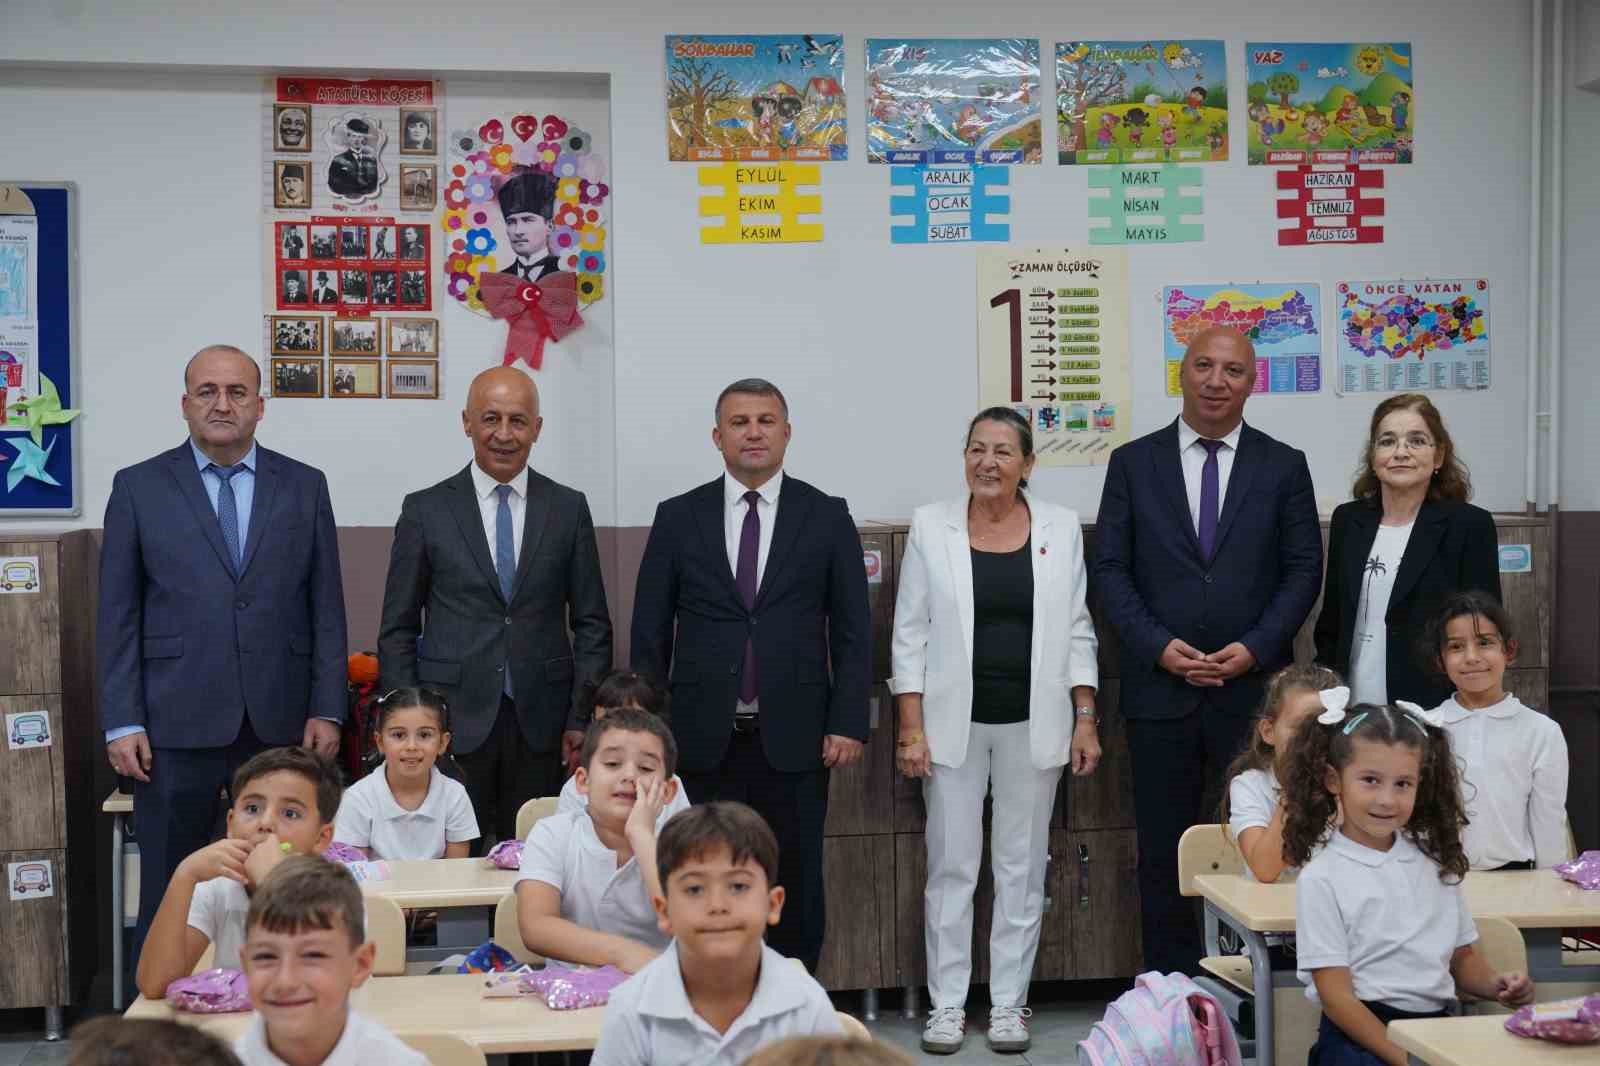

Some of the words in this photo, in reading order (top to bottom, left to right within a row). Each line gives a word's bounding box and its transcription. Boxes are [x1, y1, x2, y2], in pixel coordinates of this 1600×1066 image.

[1254, 50, 1284, 64] YAZ
[317, 85, 379, 102] ATATÜRK
[926, 171, 971, 184] ARALIK
[1122, 171, 1160, 184] MART
[928, 197, 969, 211] OCAK
[1124, 197, 1159, 212] NİSAN
[1309, 202, 1352, 215] TEMMUZ
[741, 227, 781, 239] KASIM
[1126, 228, 1168, 240] MAYIS
[1018, 263, 1053, 272] ZAMAN
[1414, 283, 1462, 294] VATAN
[990, 289, 1022, 402] 1
